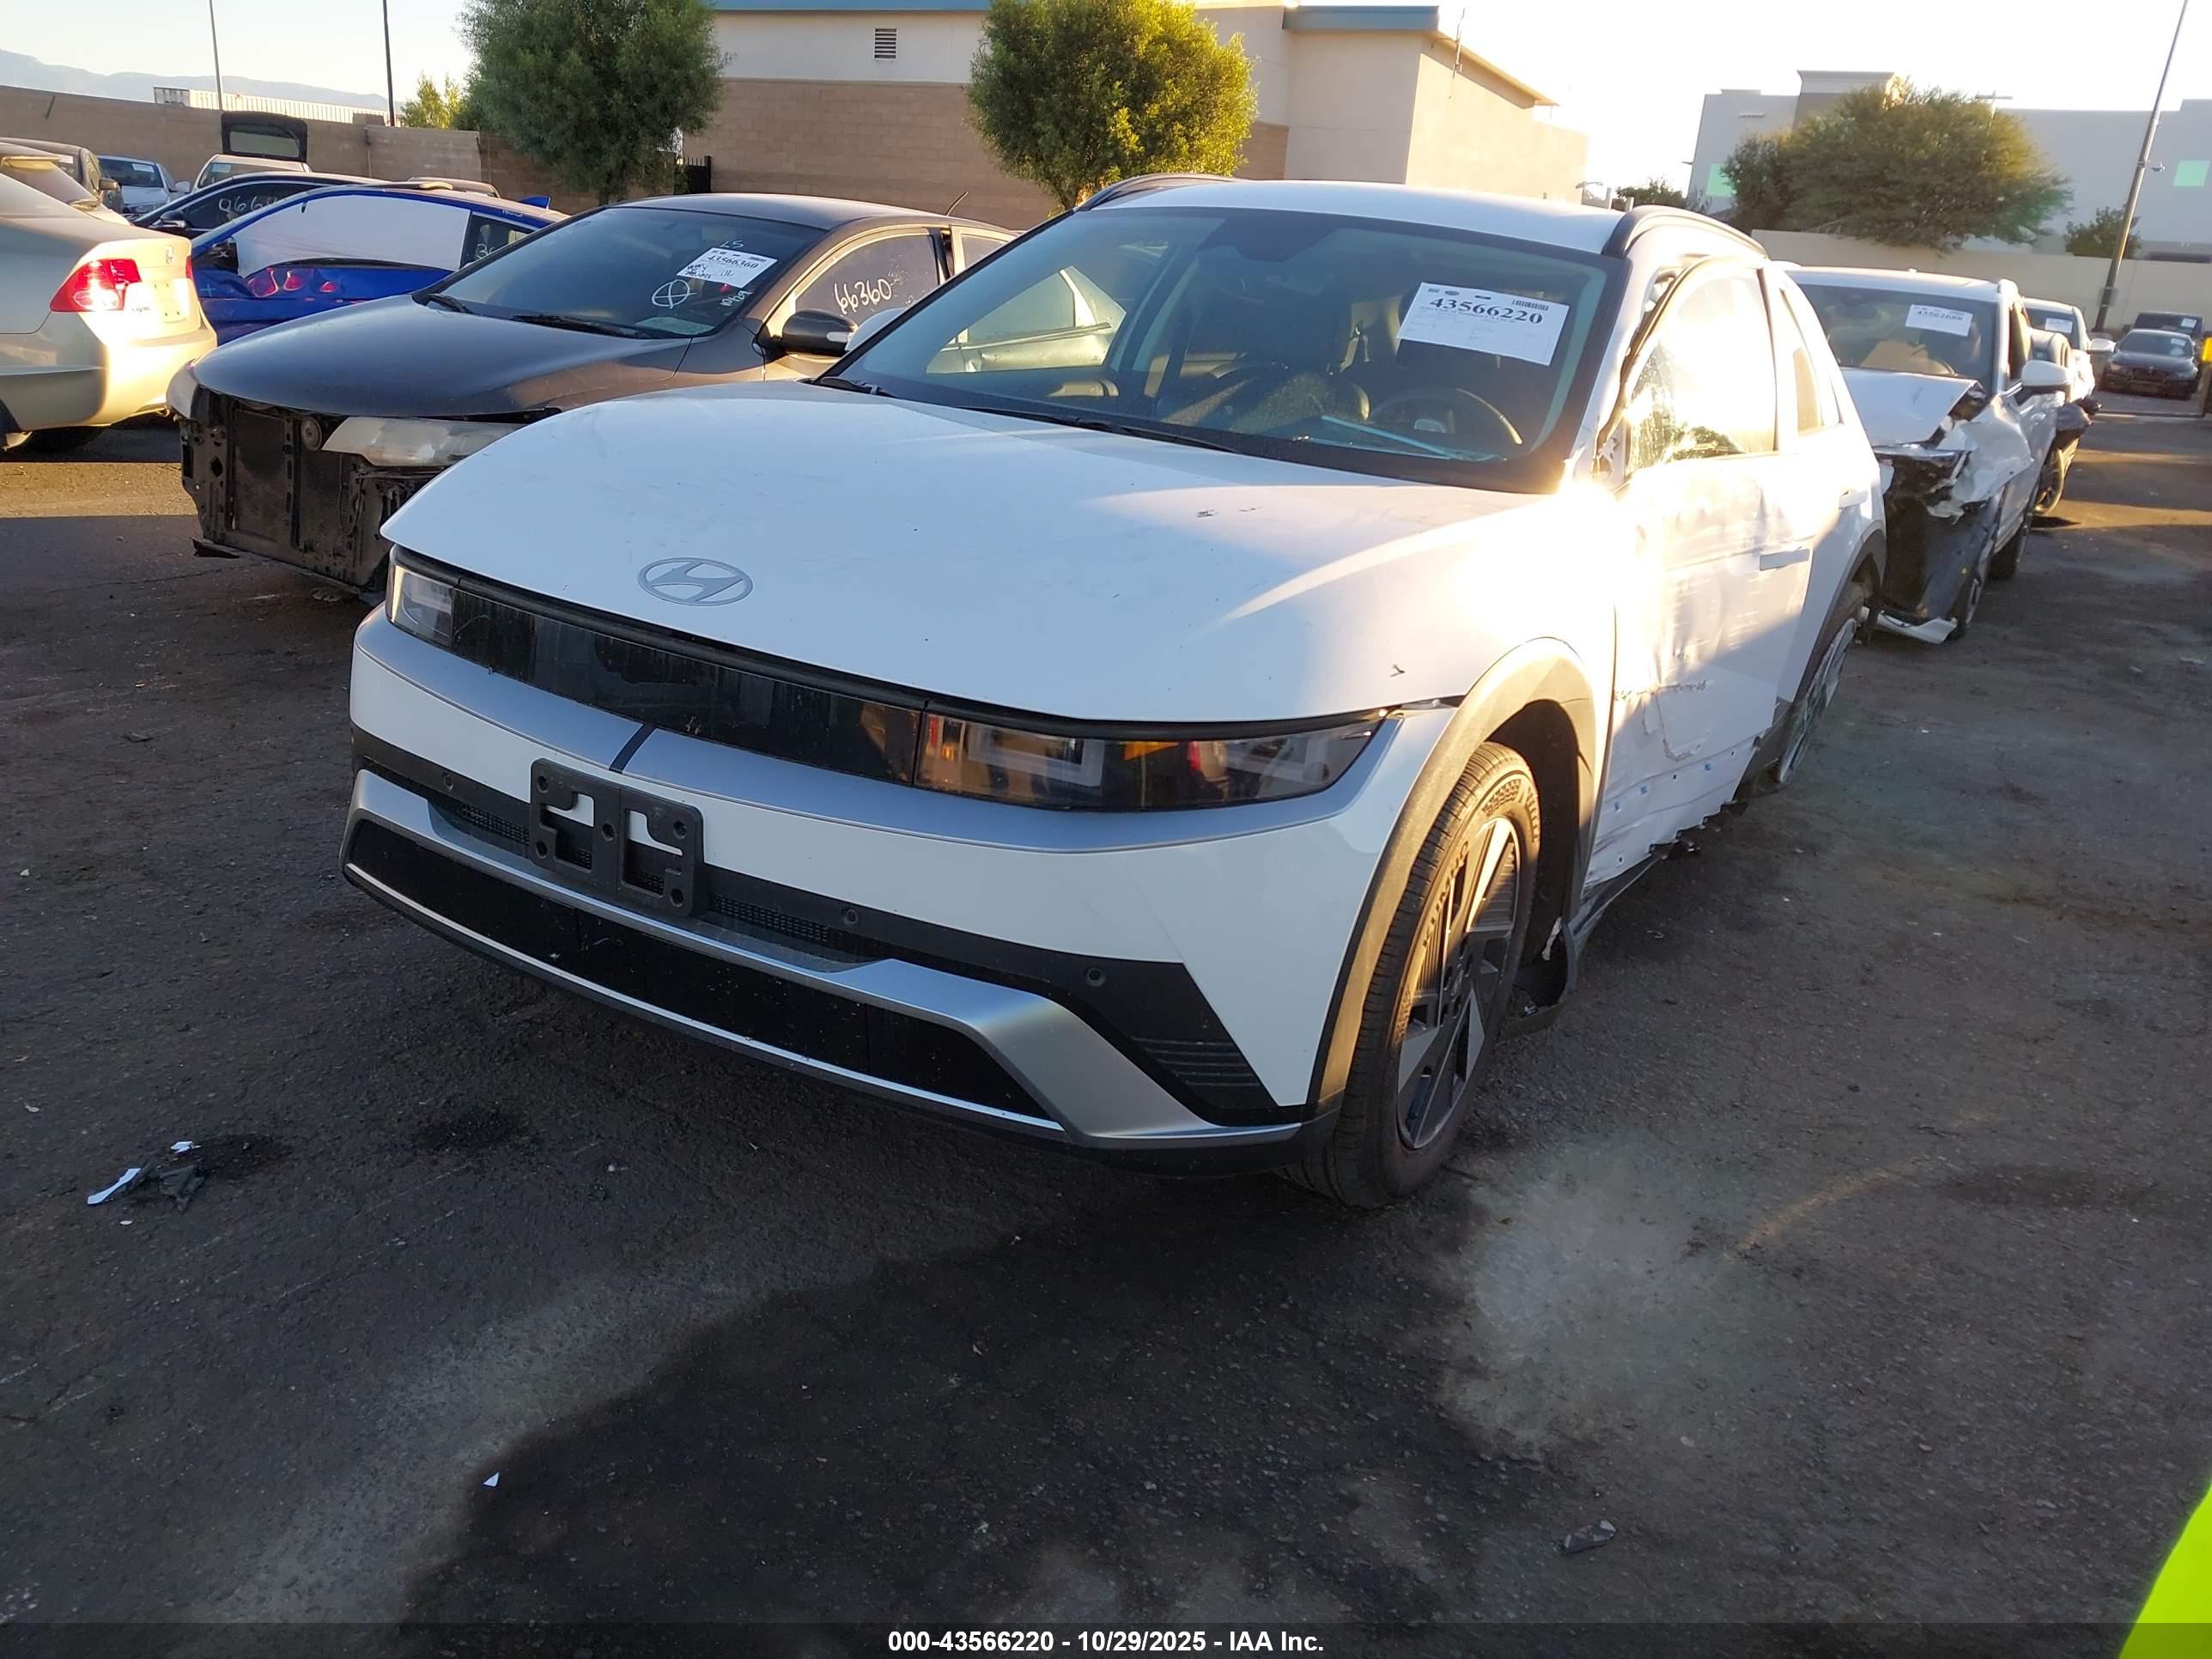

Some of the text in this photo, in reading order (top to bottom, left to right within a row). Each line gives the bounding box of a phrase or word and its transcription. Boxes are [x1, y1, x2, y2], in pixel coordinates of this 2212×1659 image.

[708, 255, 759, 270] 43566360
[834, 278, 892, 315] 66360
[1430, 298, 1543, 325] 43566220
